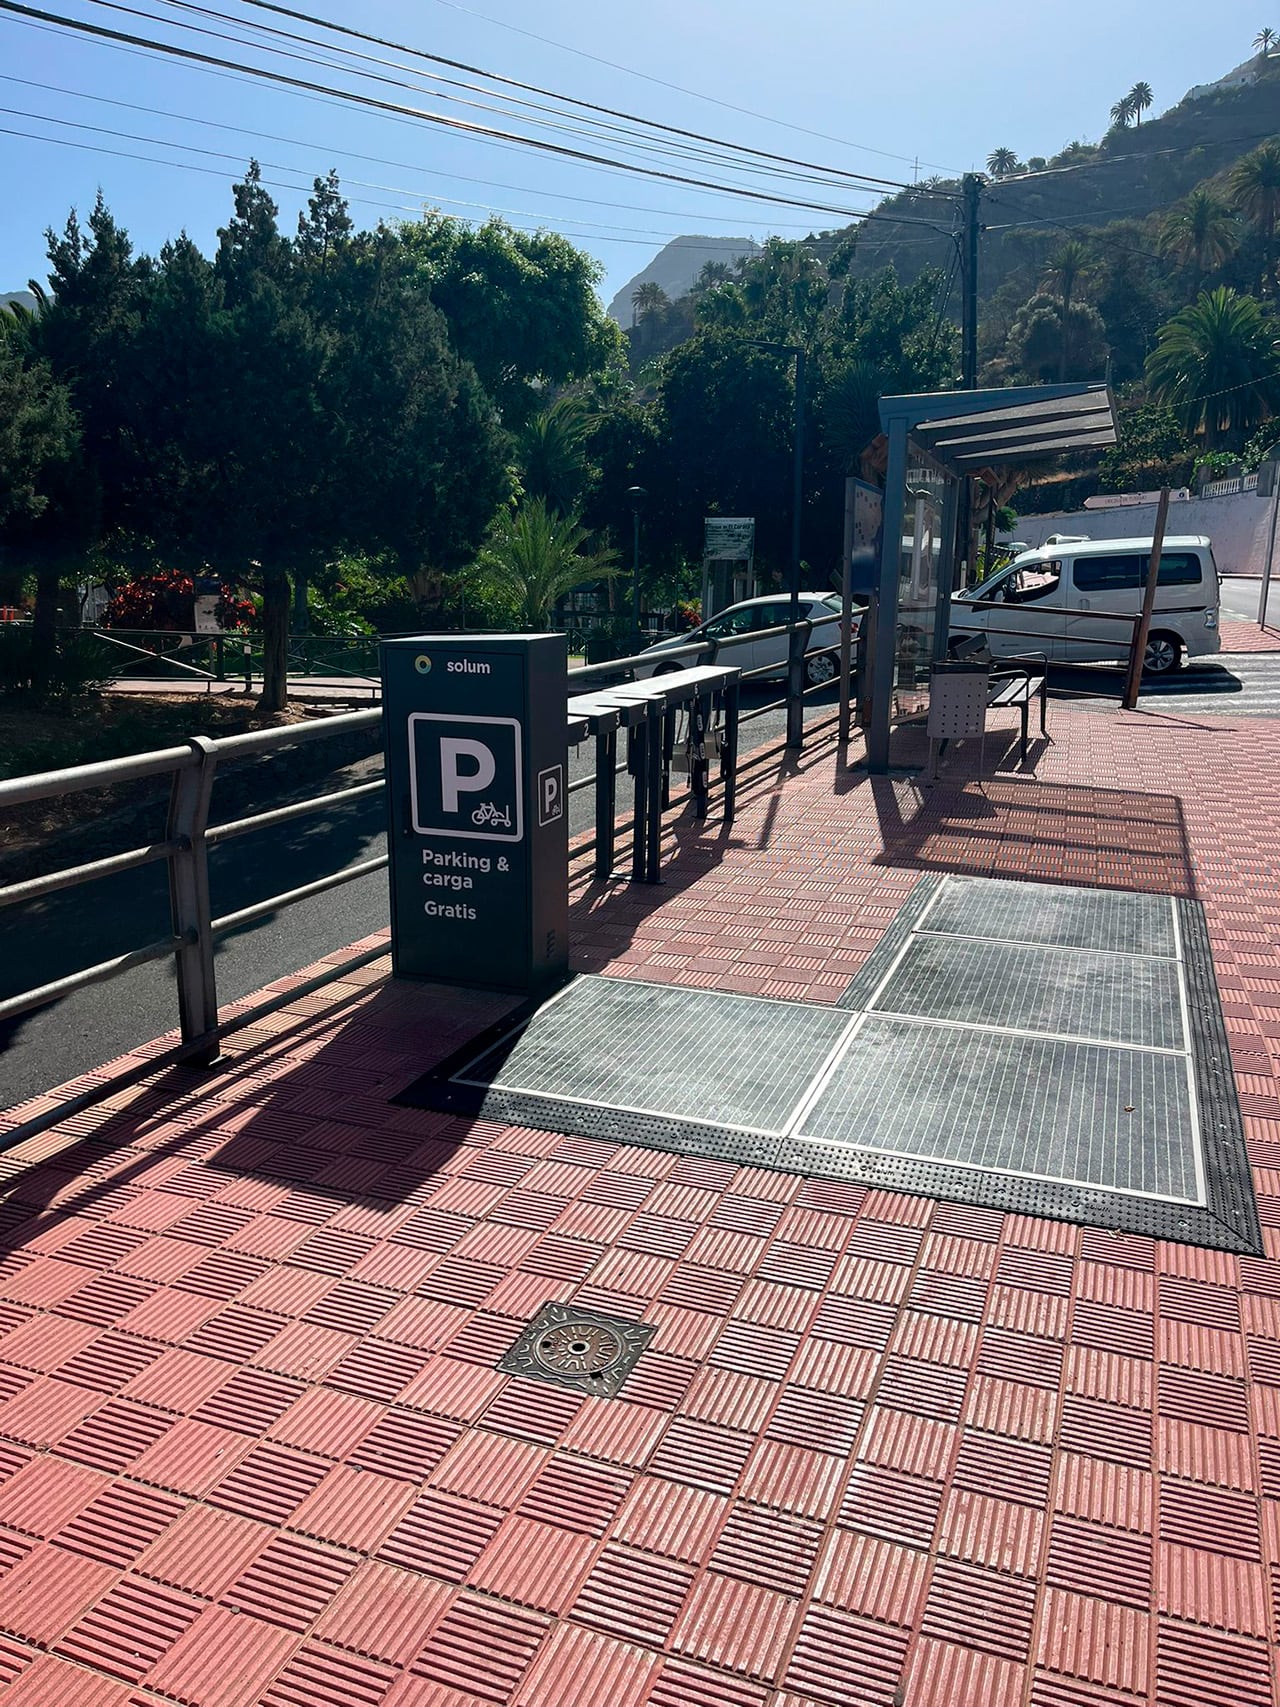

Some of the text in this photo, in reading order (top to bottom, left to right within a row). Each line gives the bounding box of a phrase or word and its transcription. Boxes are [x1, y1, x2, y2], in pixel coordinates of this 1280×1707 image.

[447, 659, 490, 674] solum
[615, 712, 620, 726] 3
[642, 704, 648, 717] 4
[583, 723, 589, 737] 2
[440, 737, 495, 813] P
[545, 777, 557, 813] P
[423, 849, 509, 873] Parking &
[423, 873, 472, 891] carga
[425, 901, 476, 920] Gratis
